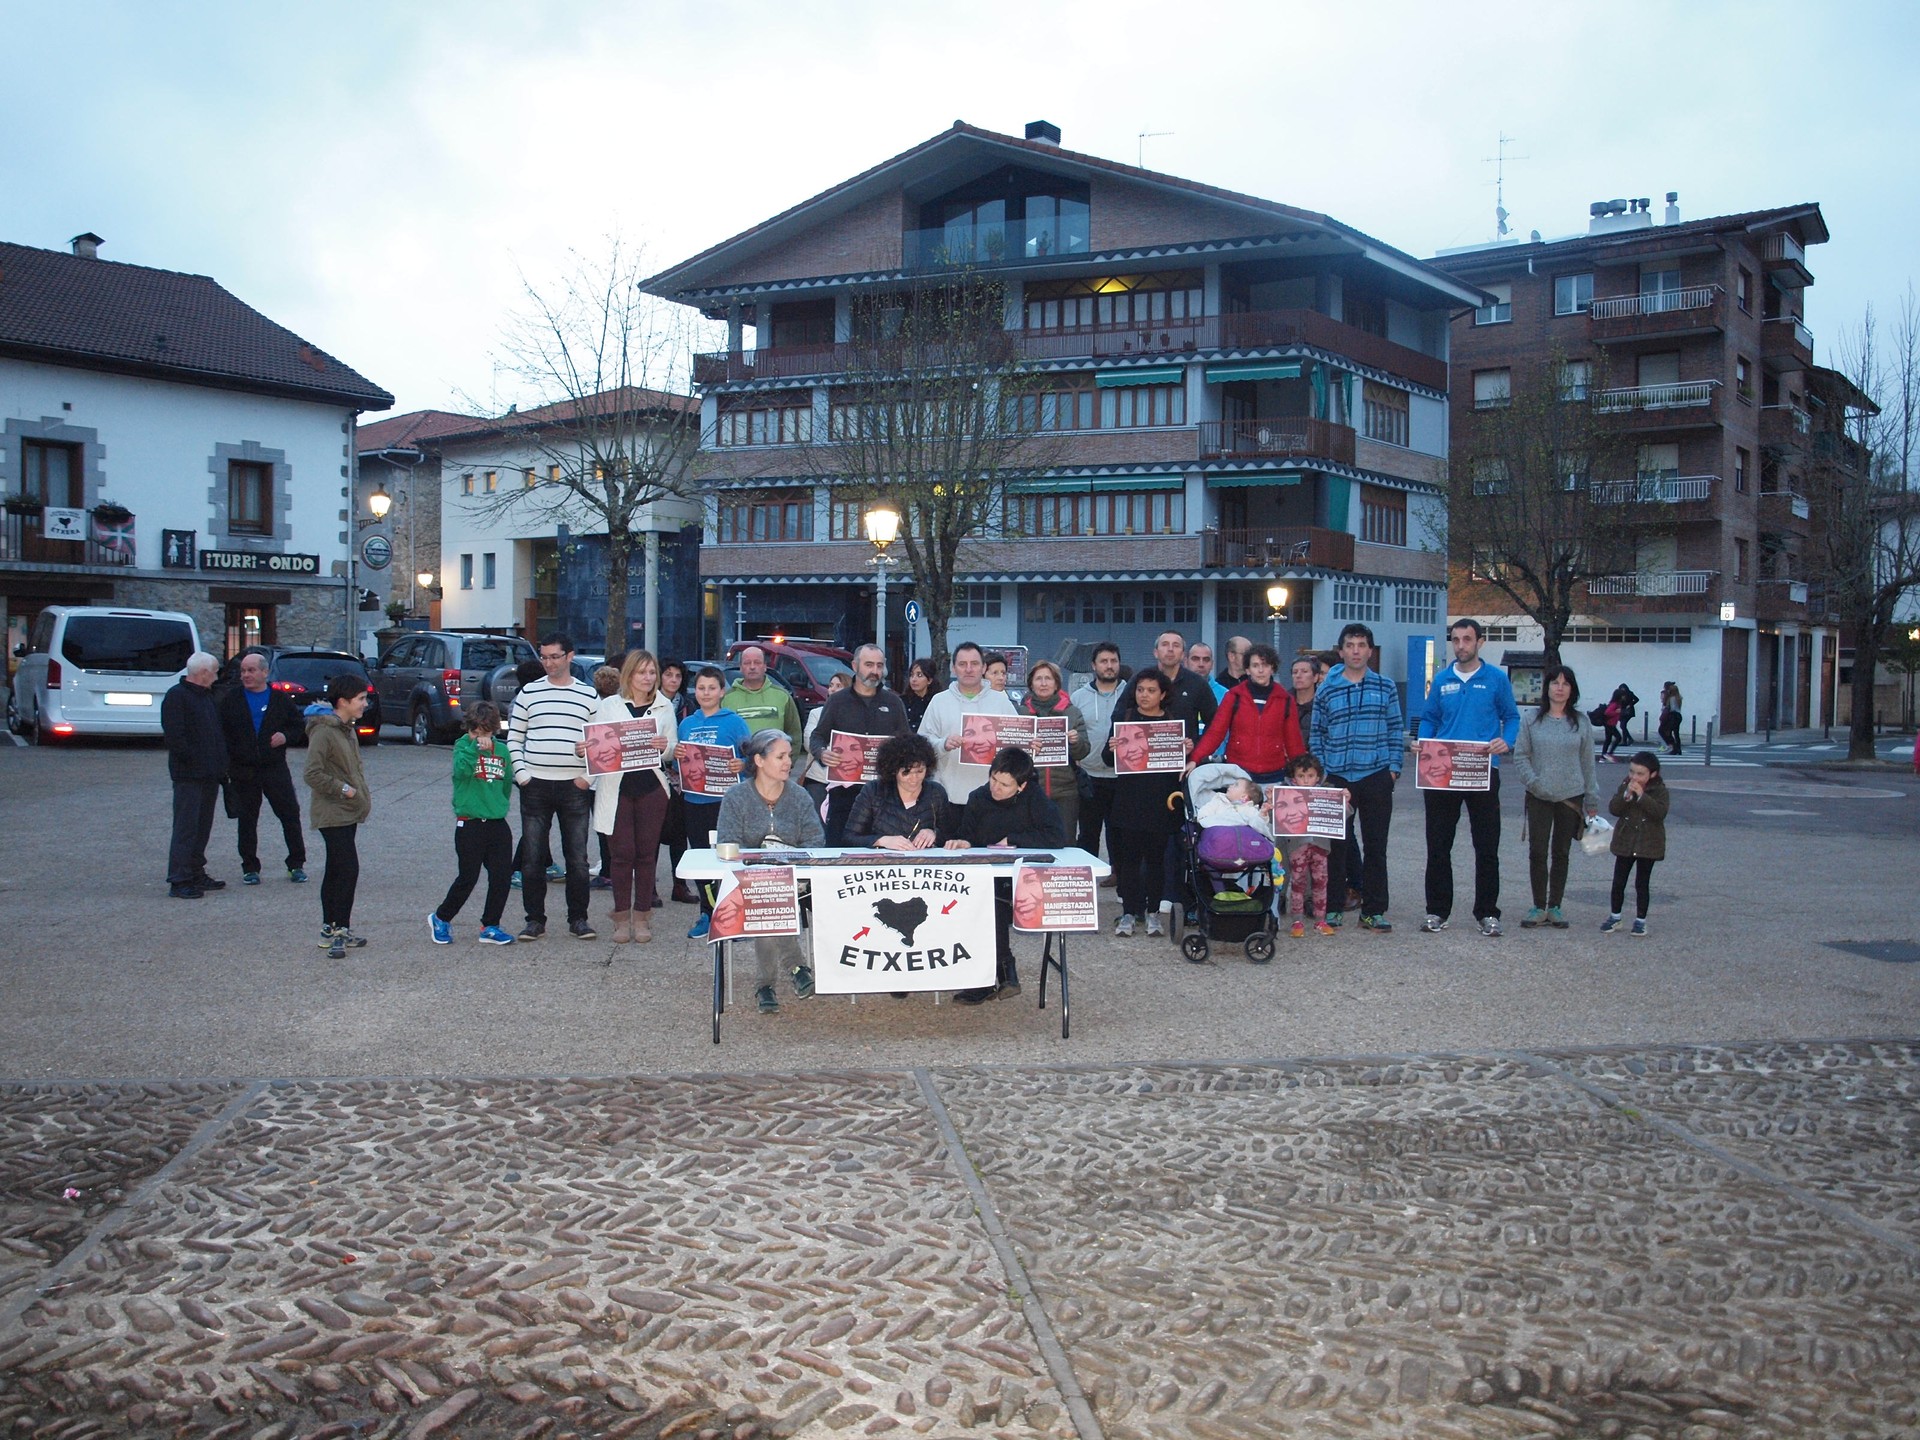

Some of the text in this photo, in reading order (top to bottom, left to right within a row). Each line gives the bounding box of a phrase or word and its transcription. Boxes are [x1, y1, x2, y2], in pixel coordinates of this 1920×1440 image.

[269, 556, 314, 571] ONDO
[843, 868, 965, 885] EUSKAL PRESO
[742, 885, 795, 894] KONTZENTRAZIOA
[837, 880, 971, 899] ETA IHESLARIAK
[1042, 880, 1093, 888] KONTZENTRAZIOA
[745, 907, 795, 916] MANIFESTAZIOA
[1044, 902, 1094, 910] MANIFESTAZIOA
[839, 942, 971, 972] ETXERA
